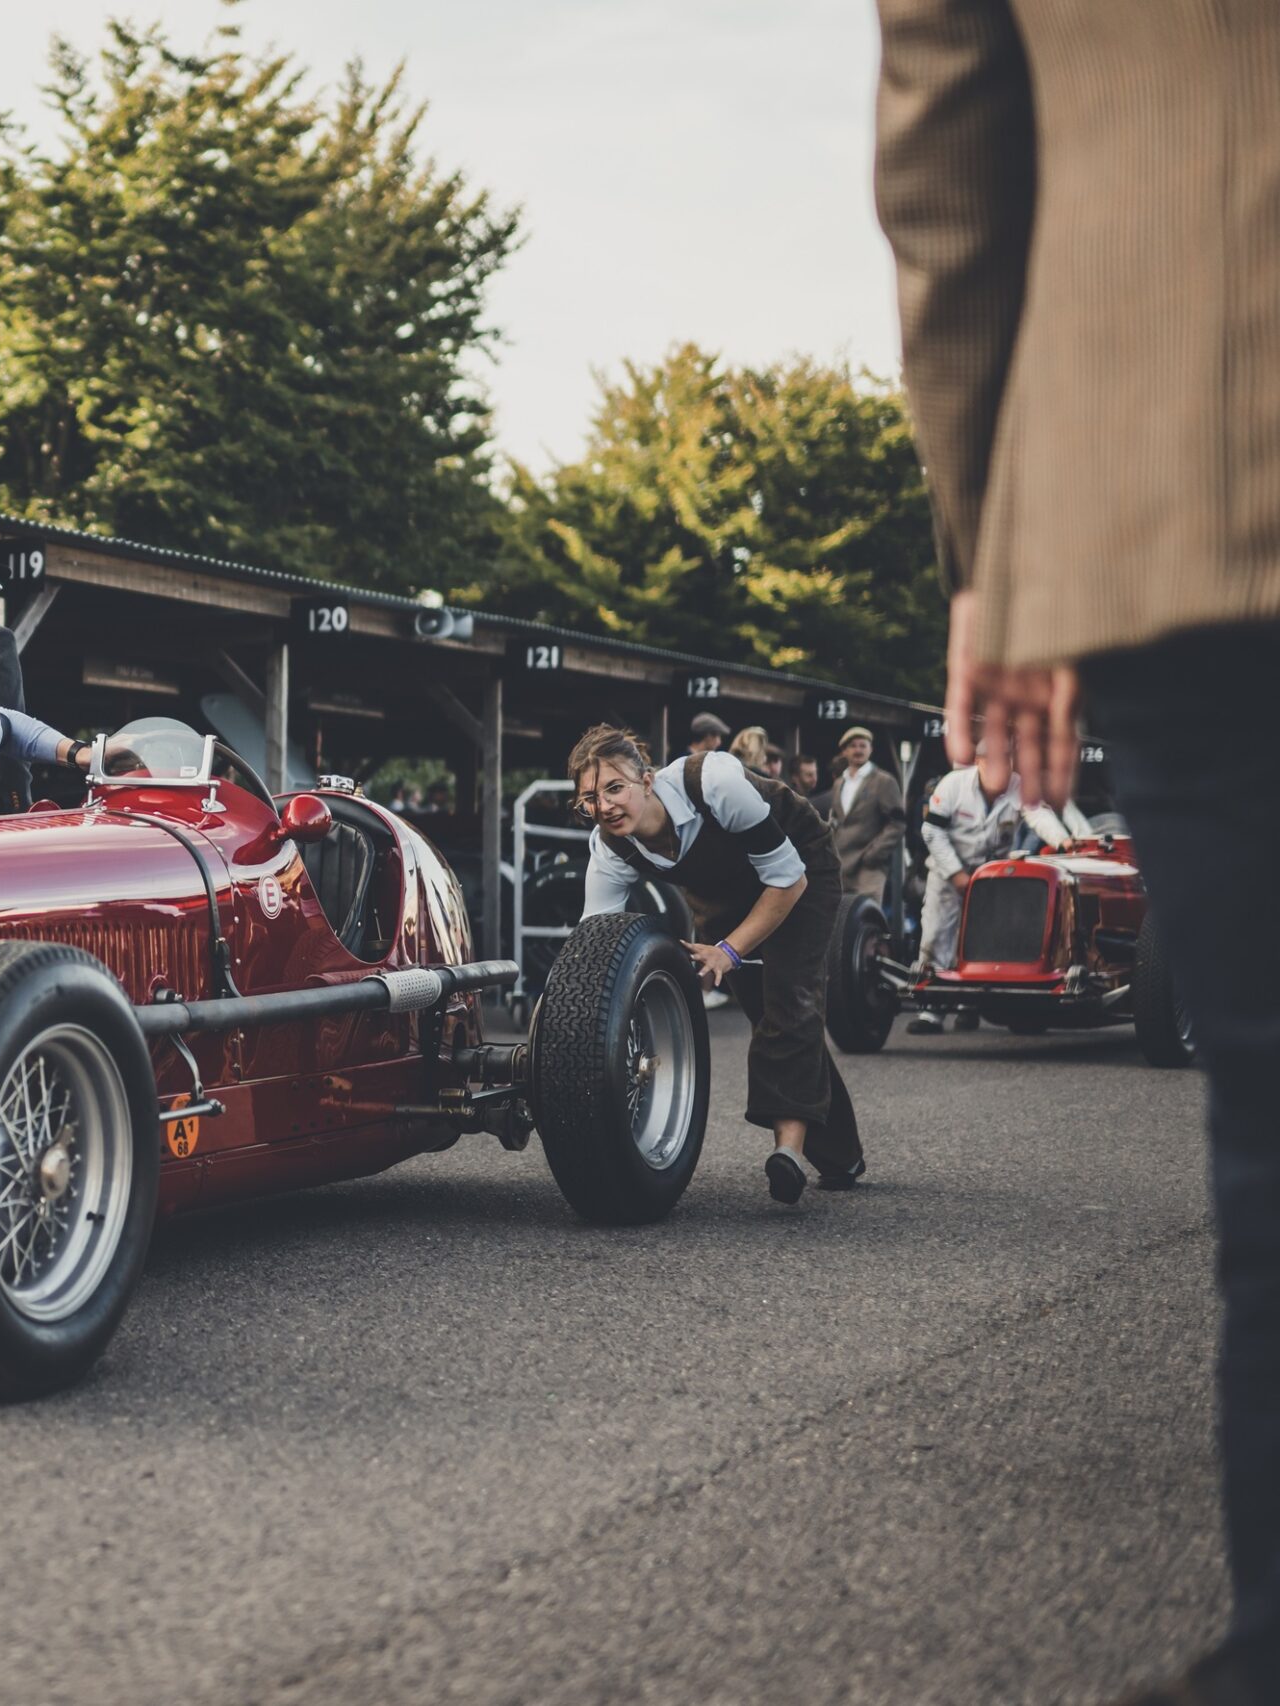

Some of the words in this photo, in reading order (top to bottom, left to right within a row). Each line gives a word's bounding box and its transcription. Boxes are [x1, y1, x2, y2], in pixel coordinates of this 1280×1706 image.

[9, 550, 43, 579] 119
[309, 606, 348, 632] 120
[526, 645, 559, 669] 121
[687, 676, 718, 698] 122
[817, 699, 847, 719] 123
[1080, 746, 1104, 762] 126
[265, 883, 276, 907] E
